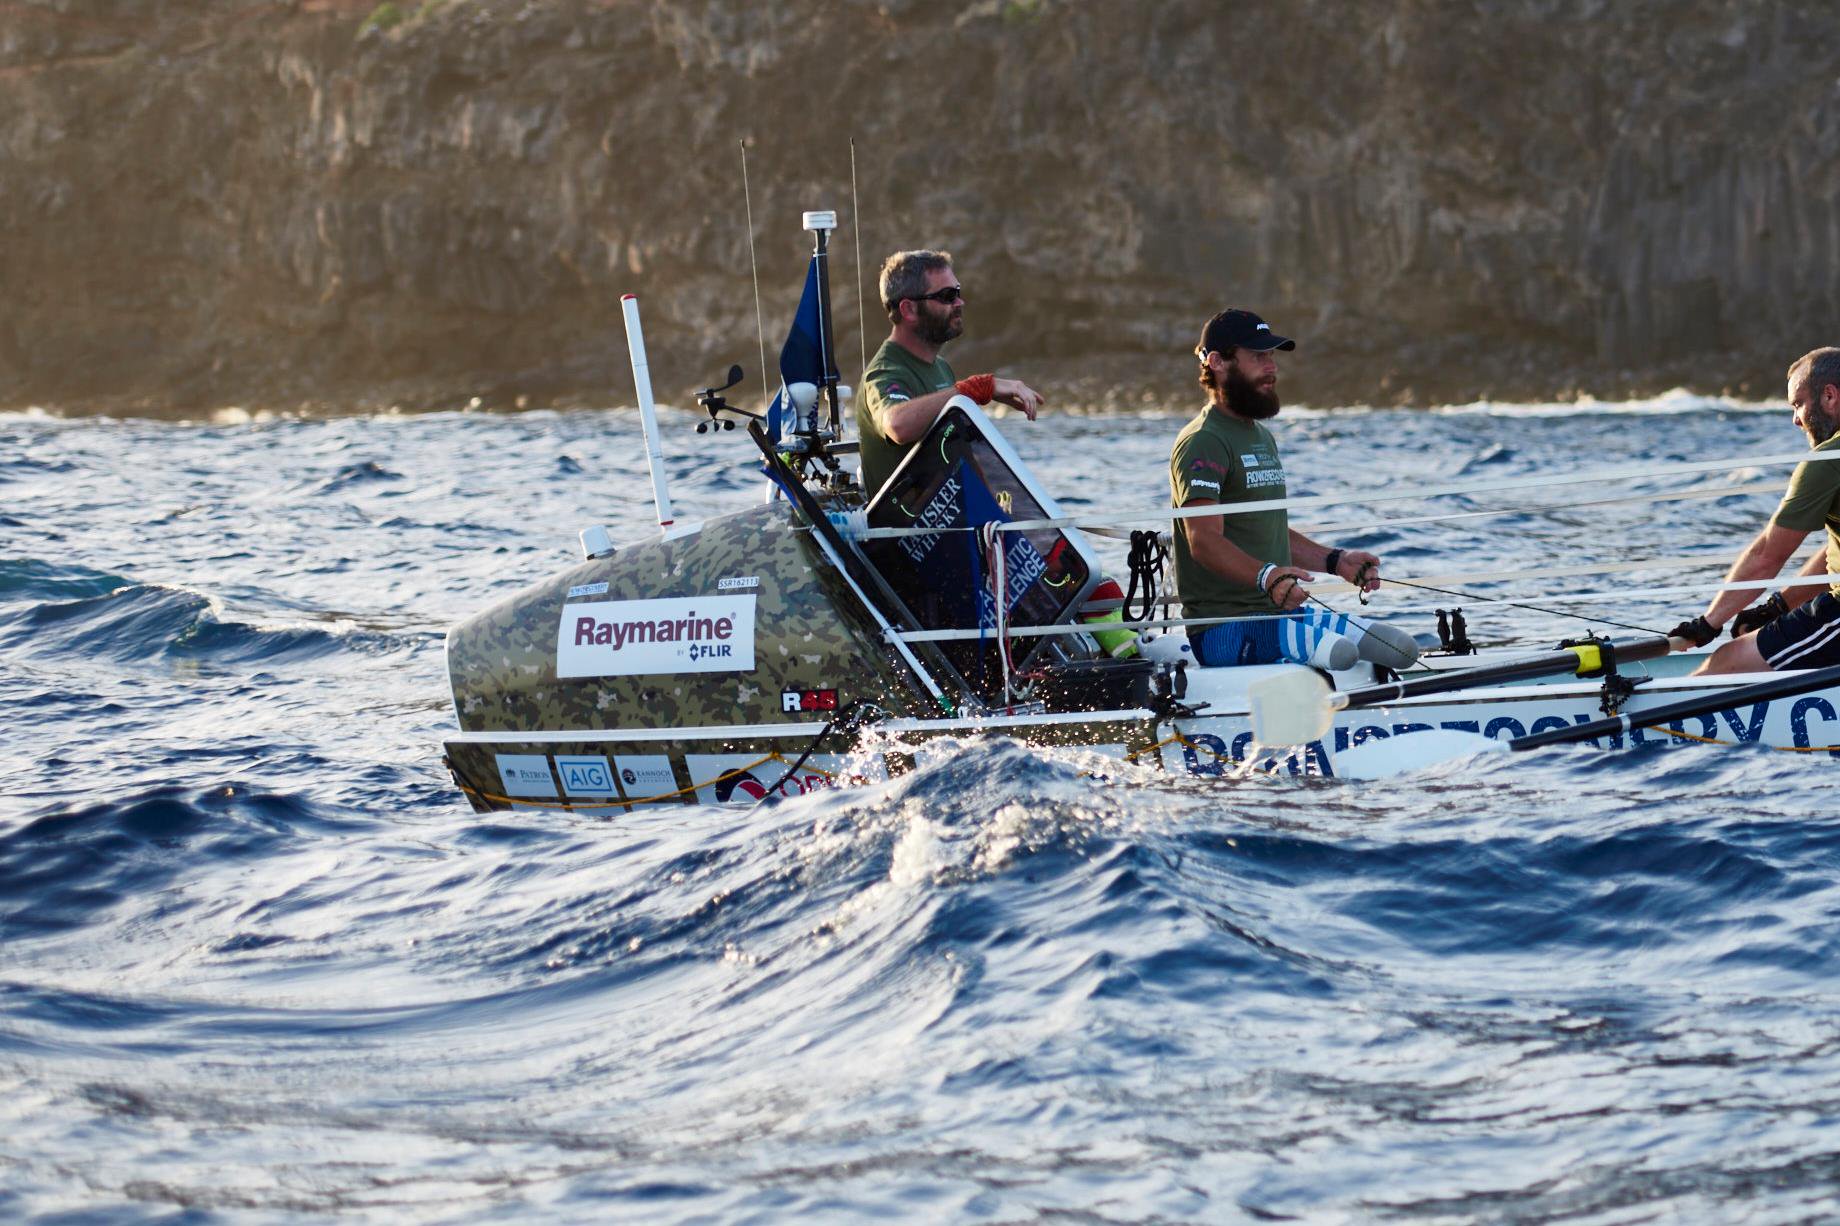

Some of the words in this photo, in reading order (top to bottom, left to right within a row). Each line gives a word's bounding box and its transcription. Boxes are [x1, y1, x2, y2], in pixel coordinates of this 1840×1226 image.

[719, 579, 758, 589] SSR162113
[701, 645, 731, 657] FLIR
[571, 768, 603, 786] AIG
